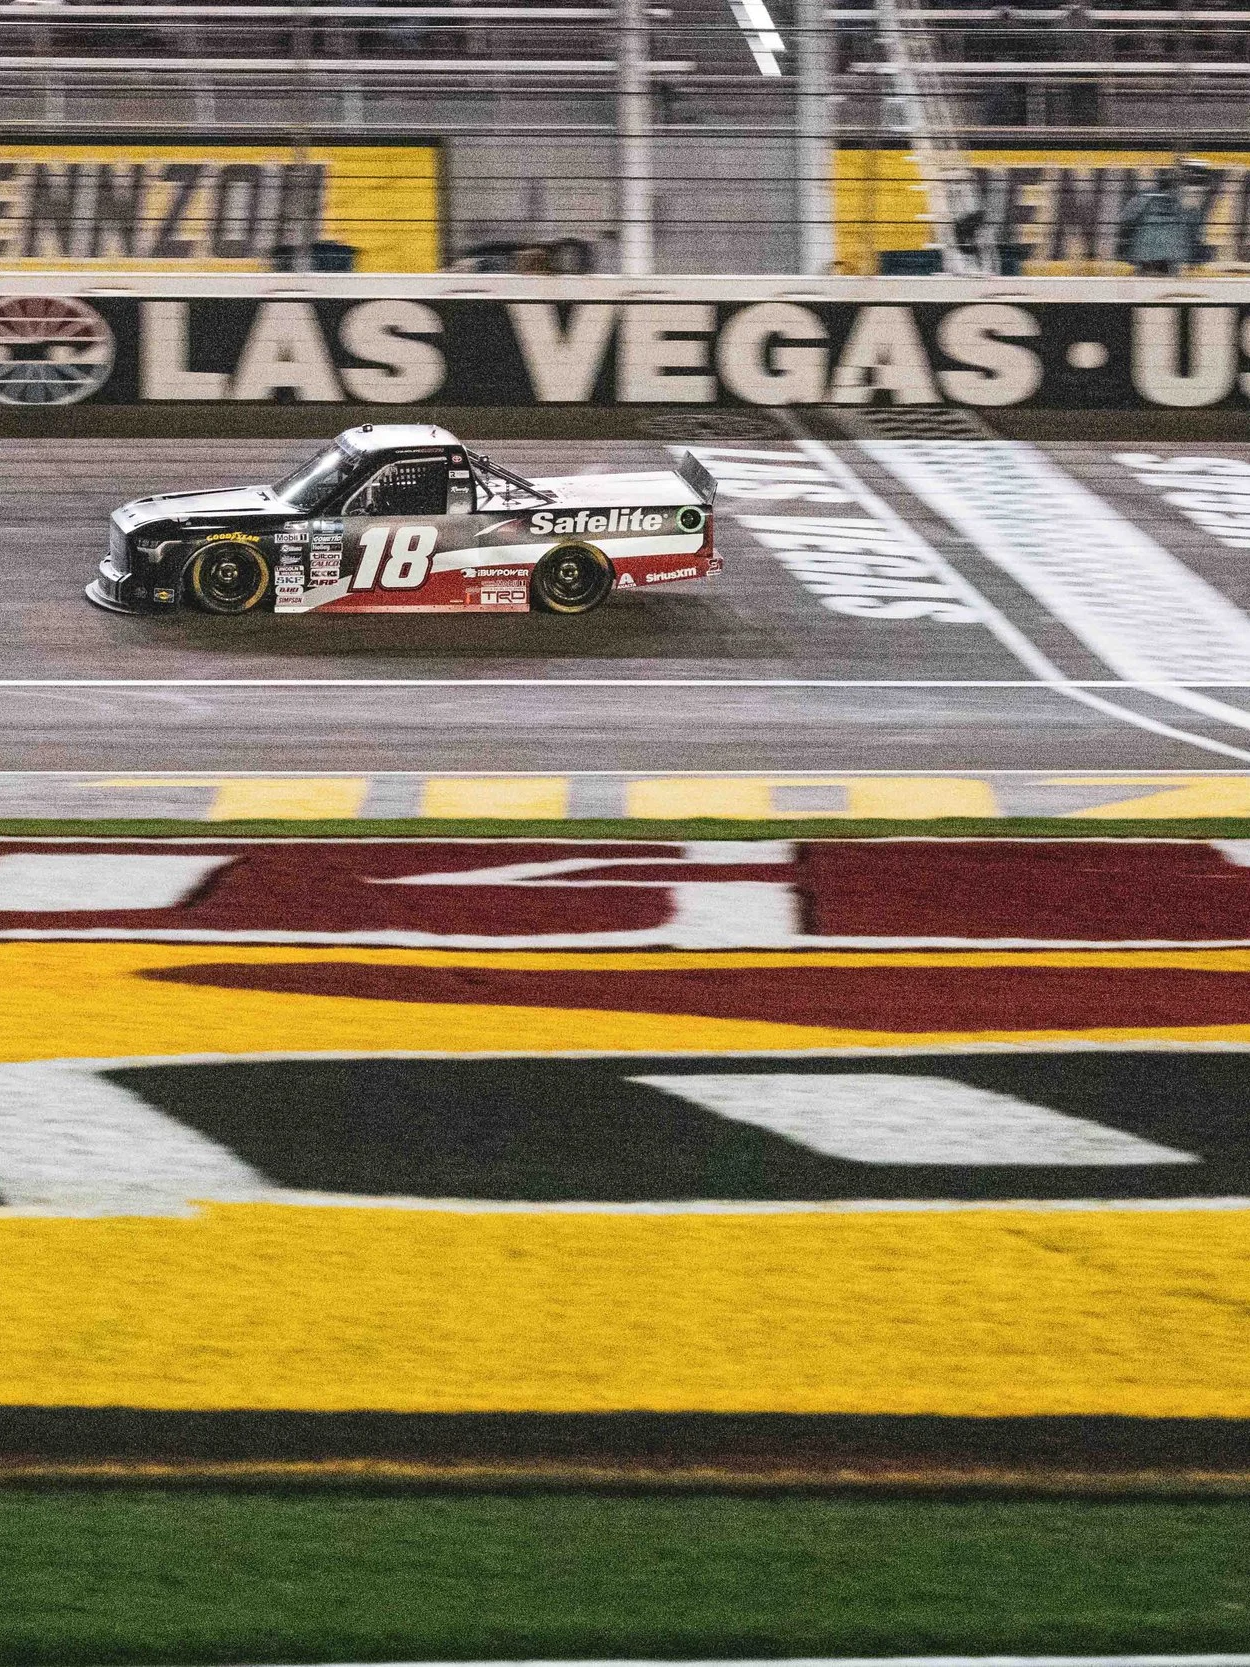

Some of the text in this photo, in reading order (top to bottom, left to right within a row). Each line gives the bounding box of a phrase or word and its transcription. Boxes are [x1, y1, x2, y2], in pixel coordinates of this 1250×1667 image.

[139, 300, 1250, 407] LAS VEGAS U
[530, 508, 663, 535] Safelite
[206, 531, 260, 543] GOODYEAR
[276, 534, 298, 542] Mobil
[350, 525, 439, 590] 18
[482, 590, 526, 603] TRD
